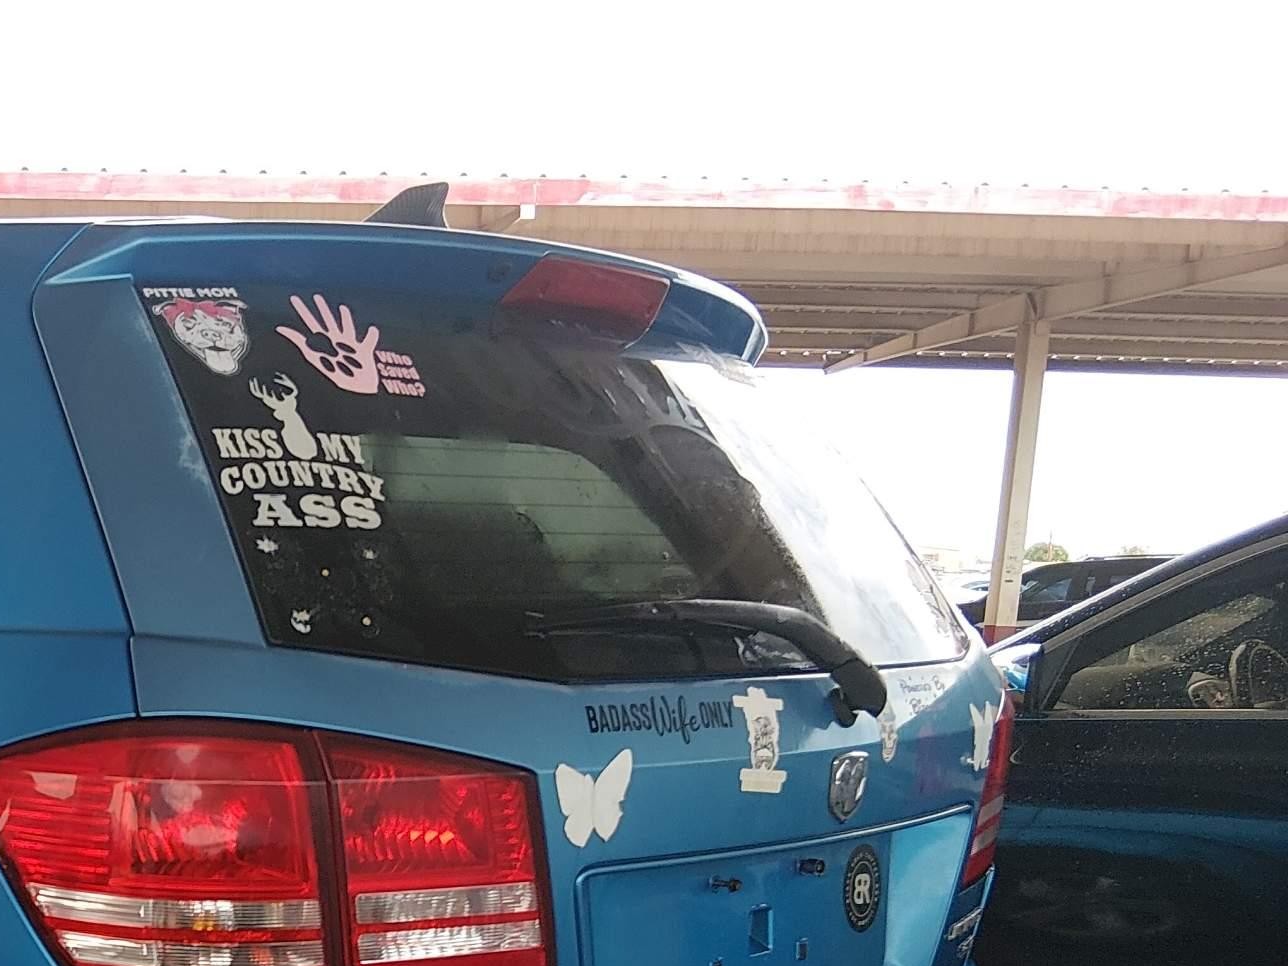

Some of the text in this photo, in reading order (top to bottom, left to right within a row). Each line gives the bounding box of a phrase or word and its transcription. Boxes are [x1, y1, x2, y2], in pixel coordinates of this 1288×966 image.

[143, 286, 239, 298] PITTIE MOM
[212, 427, 366, 464] KISS MY
[220, 461, 385, 502] COUNTRY
[253, 493, 382, 530] ASS
[585, 695, 734, 745] BADASS Wife ONLY
